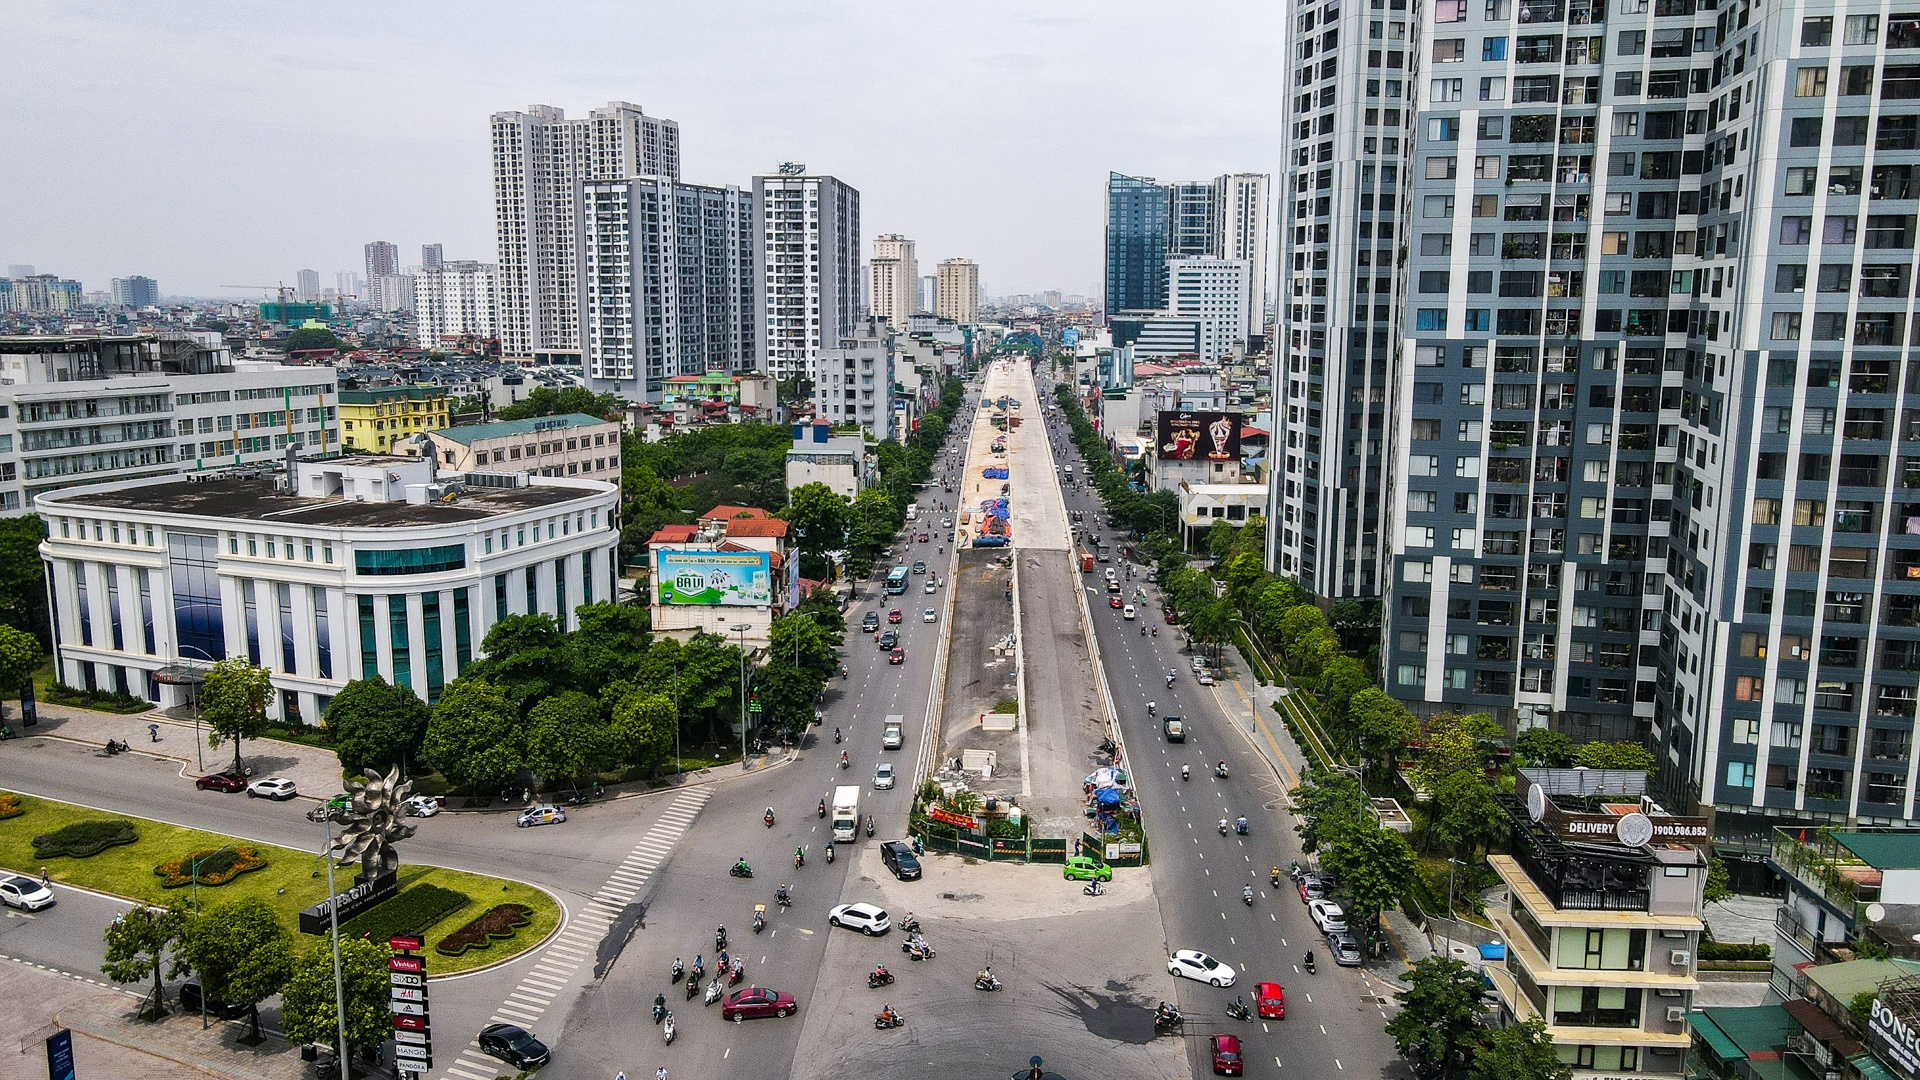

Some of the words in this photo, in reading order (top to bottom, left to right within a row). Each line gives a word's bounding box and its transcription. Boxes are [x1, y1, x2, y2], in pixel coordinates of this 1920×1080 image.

[676, 577, 691, 588] BA
[1569, 822, 1614, 834] DELIVERY
[1653, 825, 1707, 836] 1900.986.852
[349, 881, 375, 900] CITY
[392, 959, 418, 969] VinMart
[397, 1047, 425, 1056] MANGO
[399, 1062, 426, 1070] PANDORA
